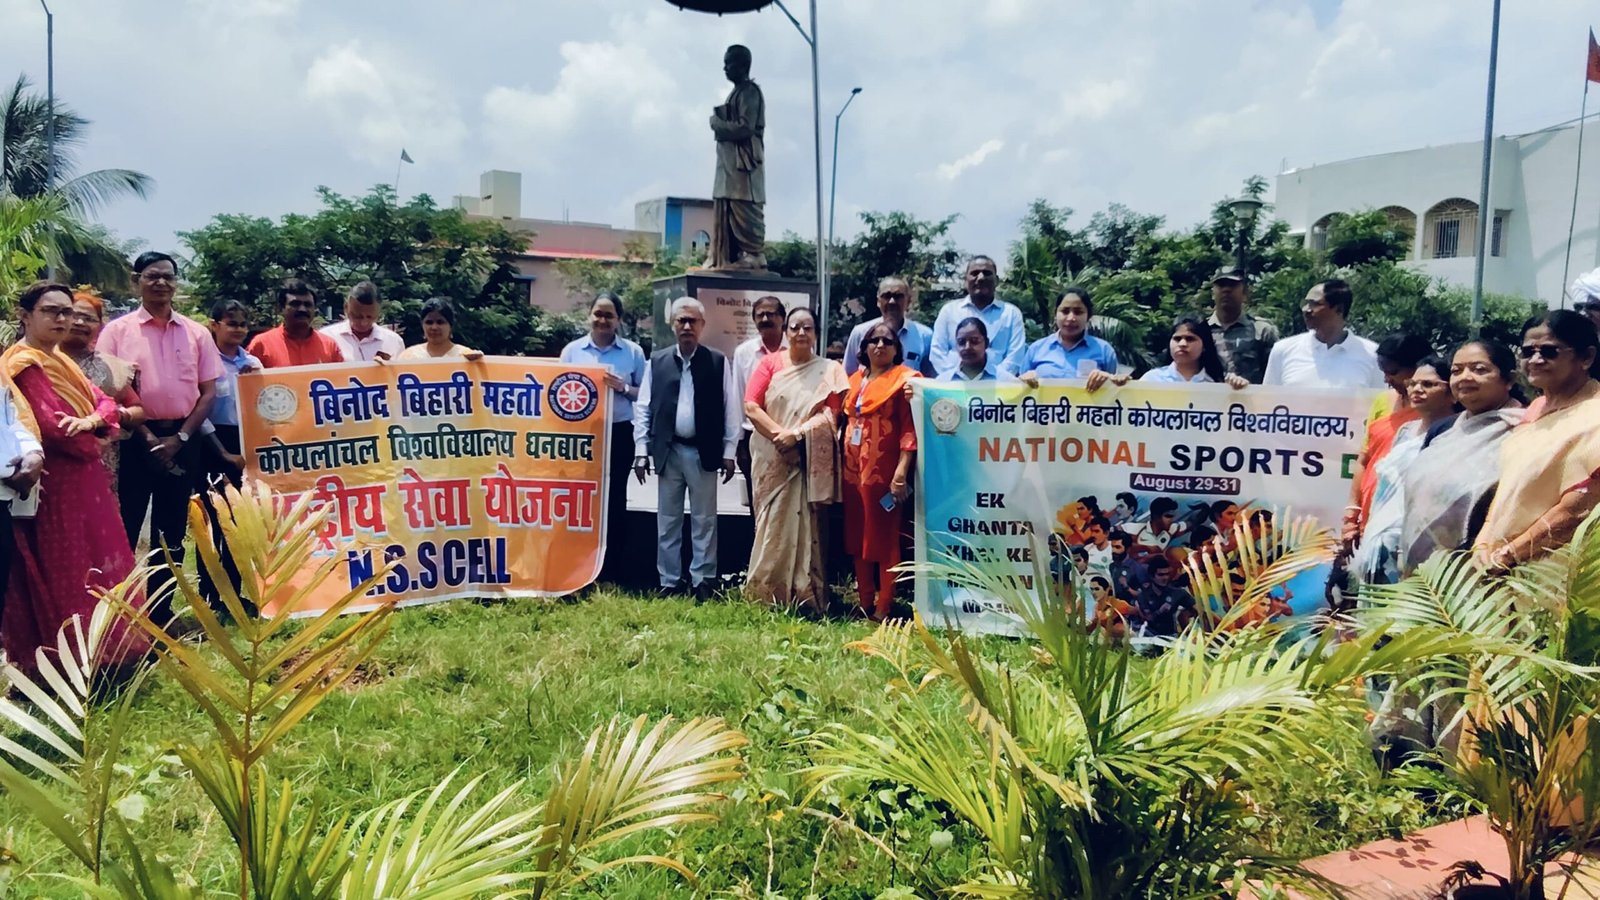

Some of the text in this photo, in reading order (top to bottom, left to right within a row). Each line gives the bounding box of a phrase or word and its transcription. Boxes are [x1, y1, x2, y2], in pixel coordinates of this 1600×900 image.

[309, 372, 543, 424] बिनोद बिहारी महतो
[969, 396, 1354, 439] बिनोद बिहारी महतो कोयलांचल विश्वविद्यालय,
[256, 424, 594, 474] कोयलांचल विश्वविद्यालय धनबाद
[979, 437, 1155, 468] NATIONAL
[1169, 444, 1324, 477] SPORTS
[399, 468, 470, 530] सेवा
[482, 464, 596, 529] योजना
[976, 492, 1005, 508] EK
[1134, 474, 1237, 493] August 29-31
[947, 517, 1034, 535] GHANTA
